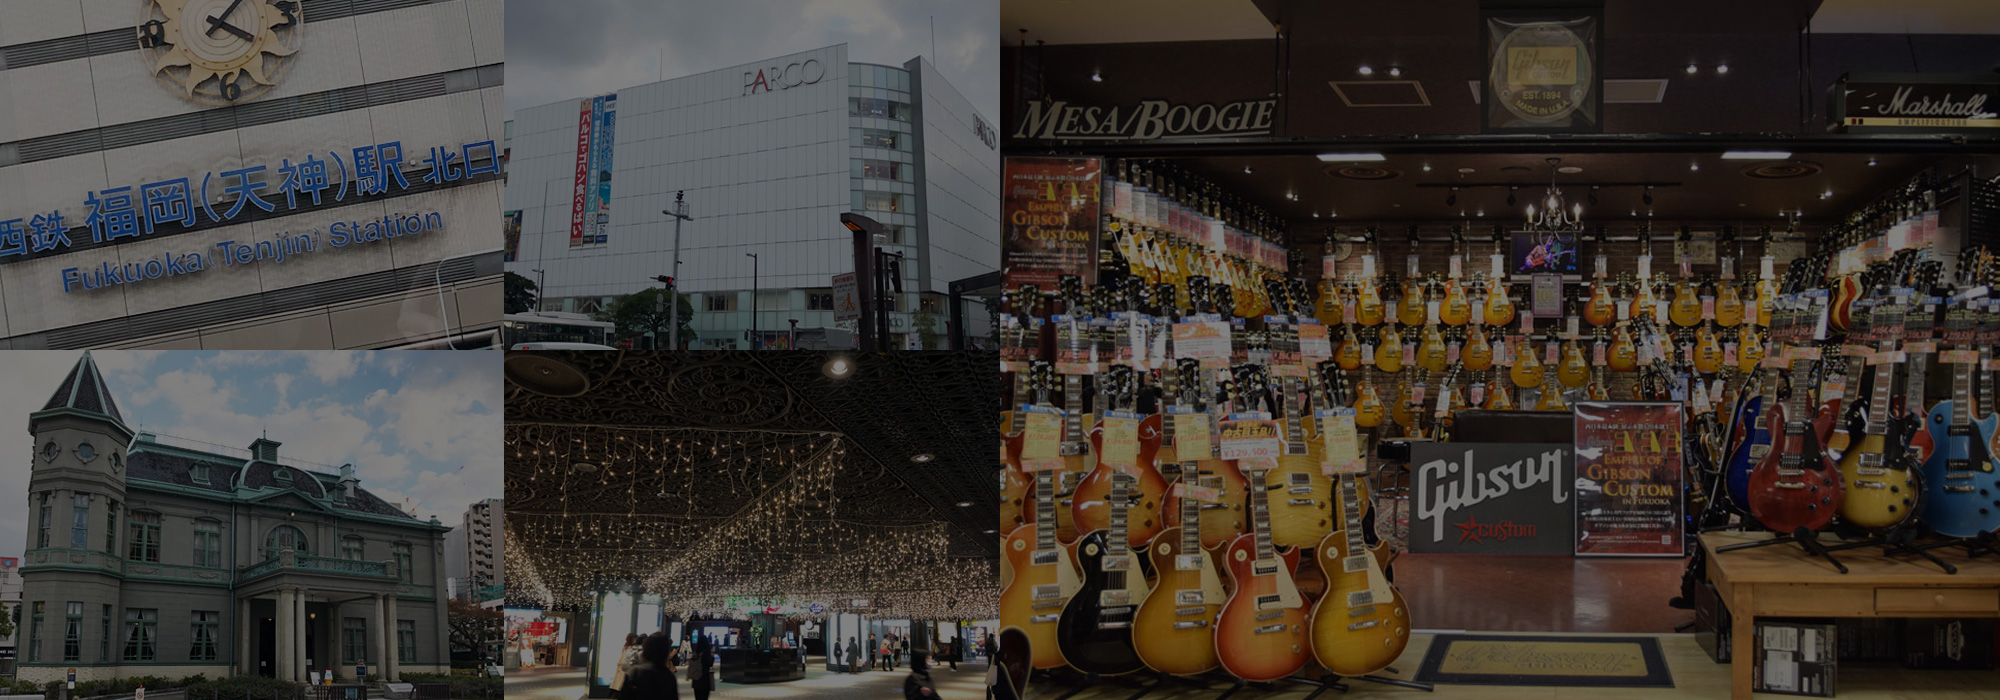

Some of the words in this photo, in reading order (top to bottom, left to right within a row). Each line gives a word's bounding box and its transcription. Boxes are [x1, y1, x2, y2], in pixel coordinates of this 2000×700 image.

[220, 71, 241, 101] 6
[742, 59, 825, 96] PARCO
[1516, 100, 1538, 114] MADE
[1878, 86, 1988, 116] Marshall
[973, 113, 996, 151] PARCO
[1013, 99, 1276, 141] MESA/BOOGIE
[0, 212, 73, 257] 西鉄
[423, 140, 501, 185] 北口
[329, 210, 443, 247] Station
[1012, 210, 1069, 225] GIBSON
[1026, 226, 1089, 241] CUSTOM
[1587, 464, 1651, 480] GIBSON
[1604, 454, 1645, 465] EMPIRE
[1418, 449, 1568, 542] Gibson
[1603, 480, 1674, 496] CUSTOM
[1633, 497, 1671, 505] FUKUOKA
